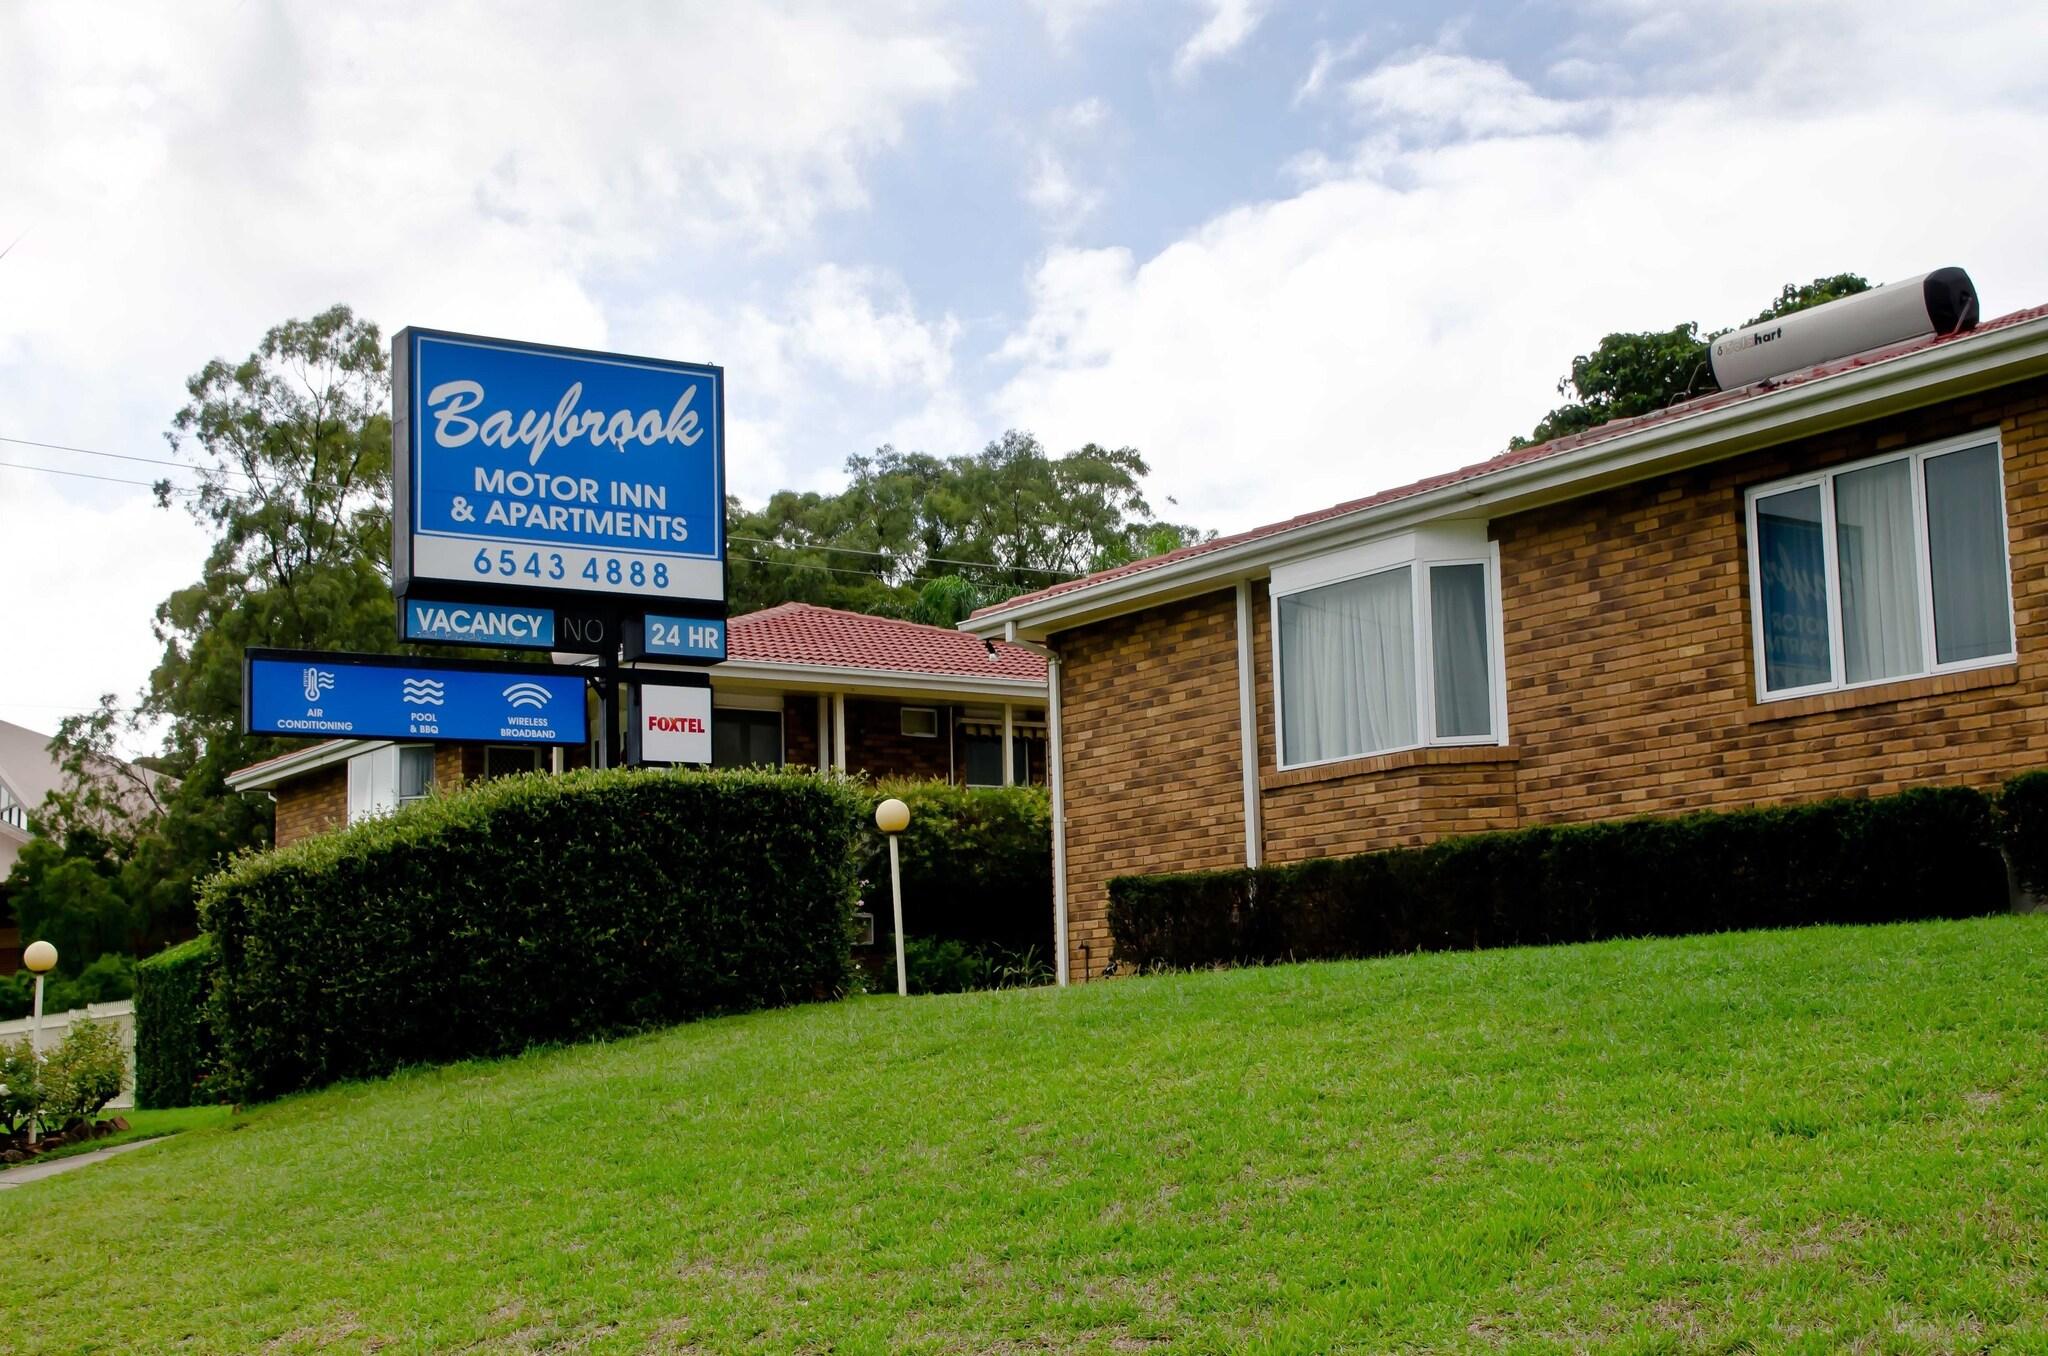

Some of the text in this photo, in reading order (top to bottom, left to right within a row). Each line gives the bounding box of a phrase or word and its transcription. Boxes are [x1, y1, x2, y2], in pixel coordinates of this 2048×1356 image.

[427, 380, 704, 466] Baybrook
[474, 467, 666, 510] MOTOR INN
[450, 496, 688, 542] & APARTMENTS
[473, 548, 670, 589] 6543 4888
[416, 607, 543, 638] VACANCY
[563, 617, 604, 643] NO
[651, 623, 719, 649] 24 HR
[307, 708, 323, 718] AIR
[410, 712, 437, 722] POOL
[507, 717, 548, 727] WIRELESS
[277, 719, 353, 731] CONDITIONING
[410, 724, 439, 734] & BBQ
[501, 728, 556, 739] BROADBAND
[648, 716, 705, 734] FOXTEL
